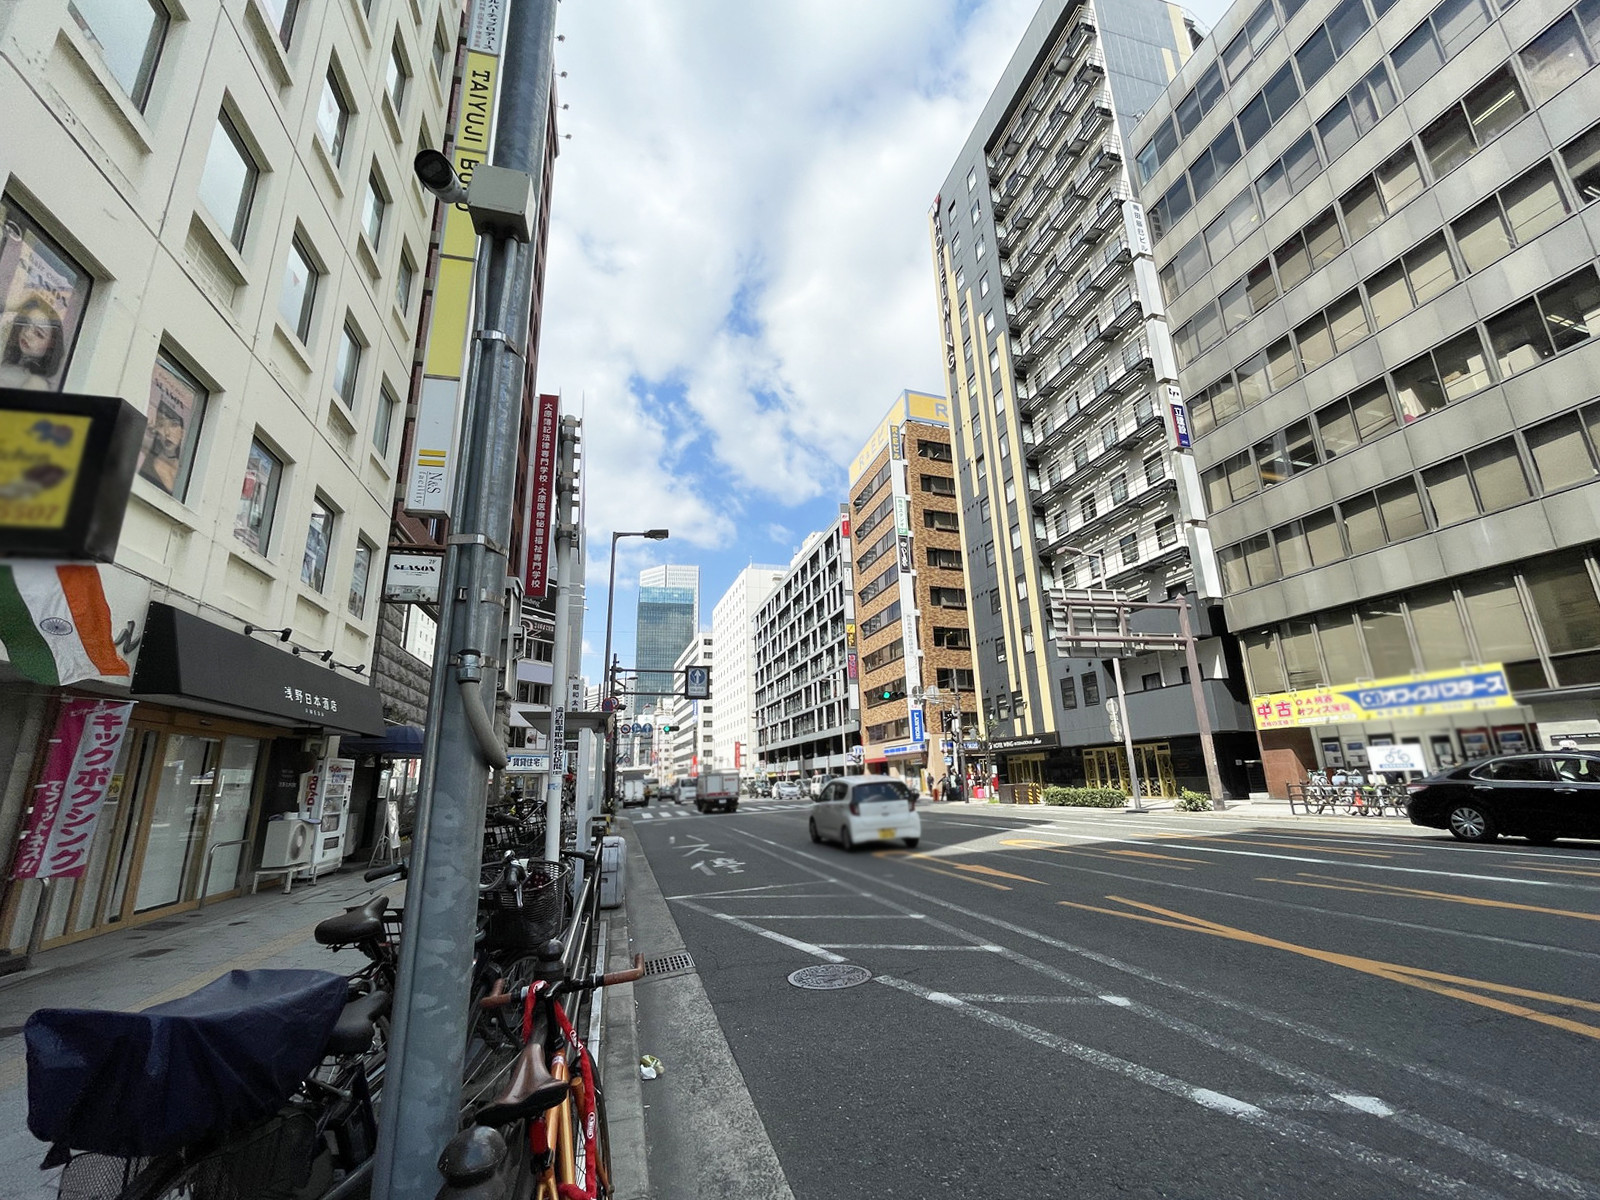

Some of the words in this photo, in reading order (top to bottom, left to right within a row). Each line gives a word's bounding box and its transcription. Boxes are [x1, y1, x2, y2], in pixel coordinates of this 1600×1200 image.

[464, 71, 490, 142] TAIYUJI
[414, 471, 424, 505] facility
[427, 471, 443, 494] N&S
[393, 563, 435, 572] SEASON
[284, 686, 338, 712] 浅野日本酒店
[1257, 701, 1291, 720] 中古
[513, 758, 541, 767] 賃貸住宅
[50, 713, 123, 870] キックボクシング
[306, 775, 319, 806] DyDo
